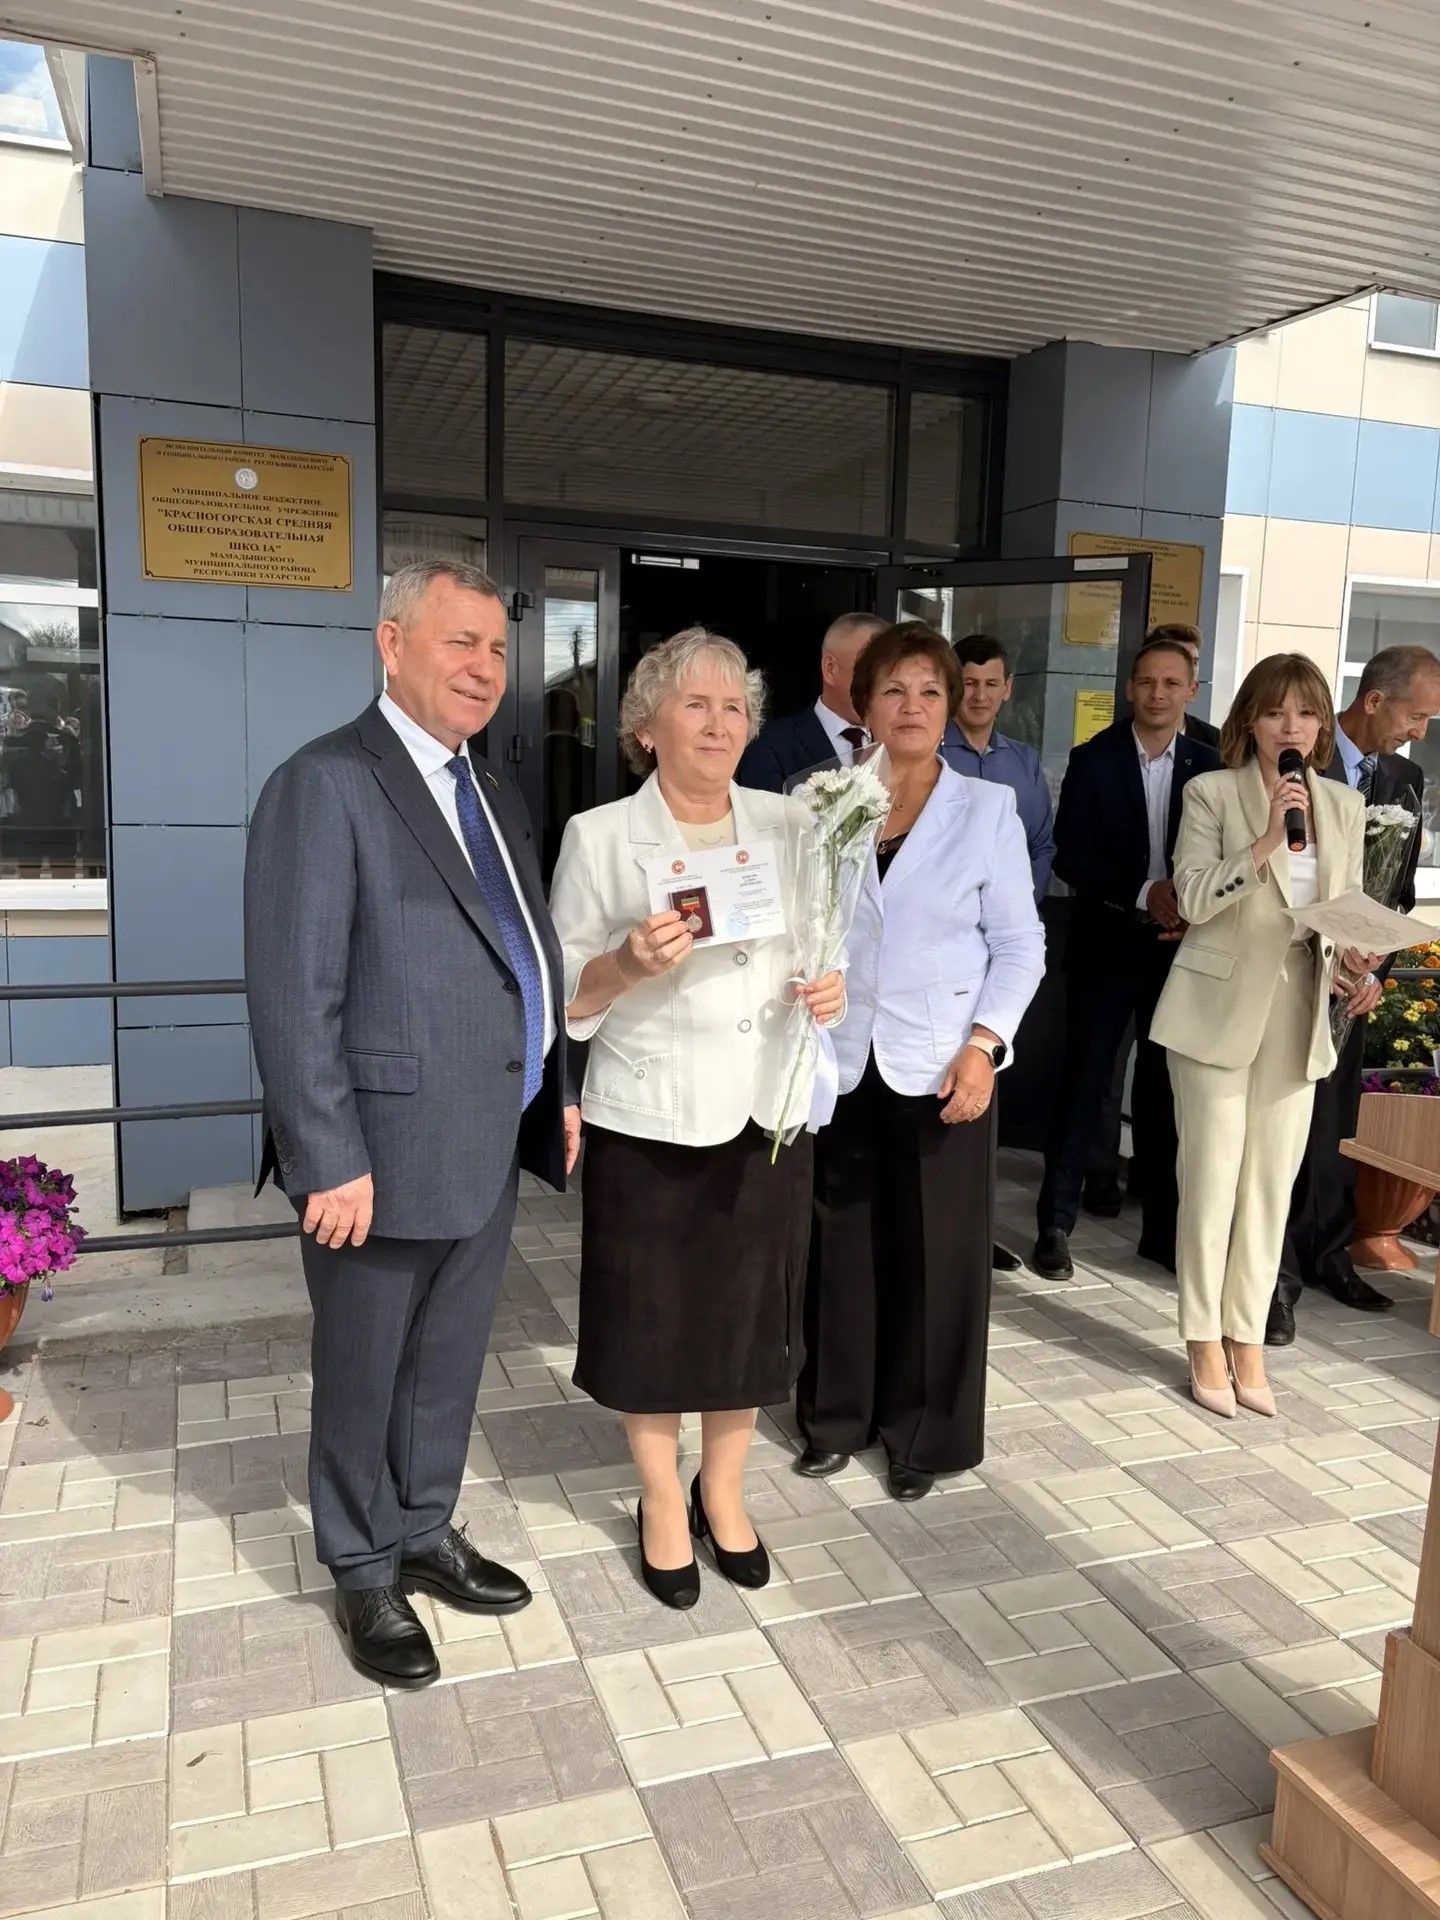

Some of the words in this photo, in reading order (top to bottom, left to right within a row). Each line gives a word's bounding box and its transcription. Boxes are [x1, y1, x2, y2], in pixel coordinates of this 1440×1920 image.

[233, 449, 265, 458] КОМИТЕТ
[254, 459, 297, 469] РЕСПУБЛИКИ
[299, 464, 335, 472] ТАТАРСТАН
[171, 487, 259, 501] МУНИЦИПАЛЬНОЕ
[263, 495, 322, 506] БЮДЖЕТНОЕ
[152, 496, 272, 512] ОБЩЕОБРАЗОВАТЕЛЬНОЕ
[278, 507, 339, 518] УЧРЕЖДЕНИЕ
[157, 508, 272, 525] "КРАСНОГОРСКАЯ
[276, 518, 332, 530] СРЕДНЯЯ
[168, 523, 324, 543] ОБЩЕОБРАЗОВАТЕЛЬНАЯ
[210, 552, 295, 563] МАМАДЫШСКОГО
[185, 559, 279, 571] МУНИЦИПАЛЬНОГО
[280, 565, 317, 573] РАЙОНА
[193, 568, 257, 578] РЕСПУБЛИКИ
[259, 573, 311, 582] ТАТАРСТАН
